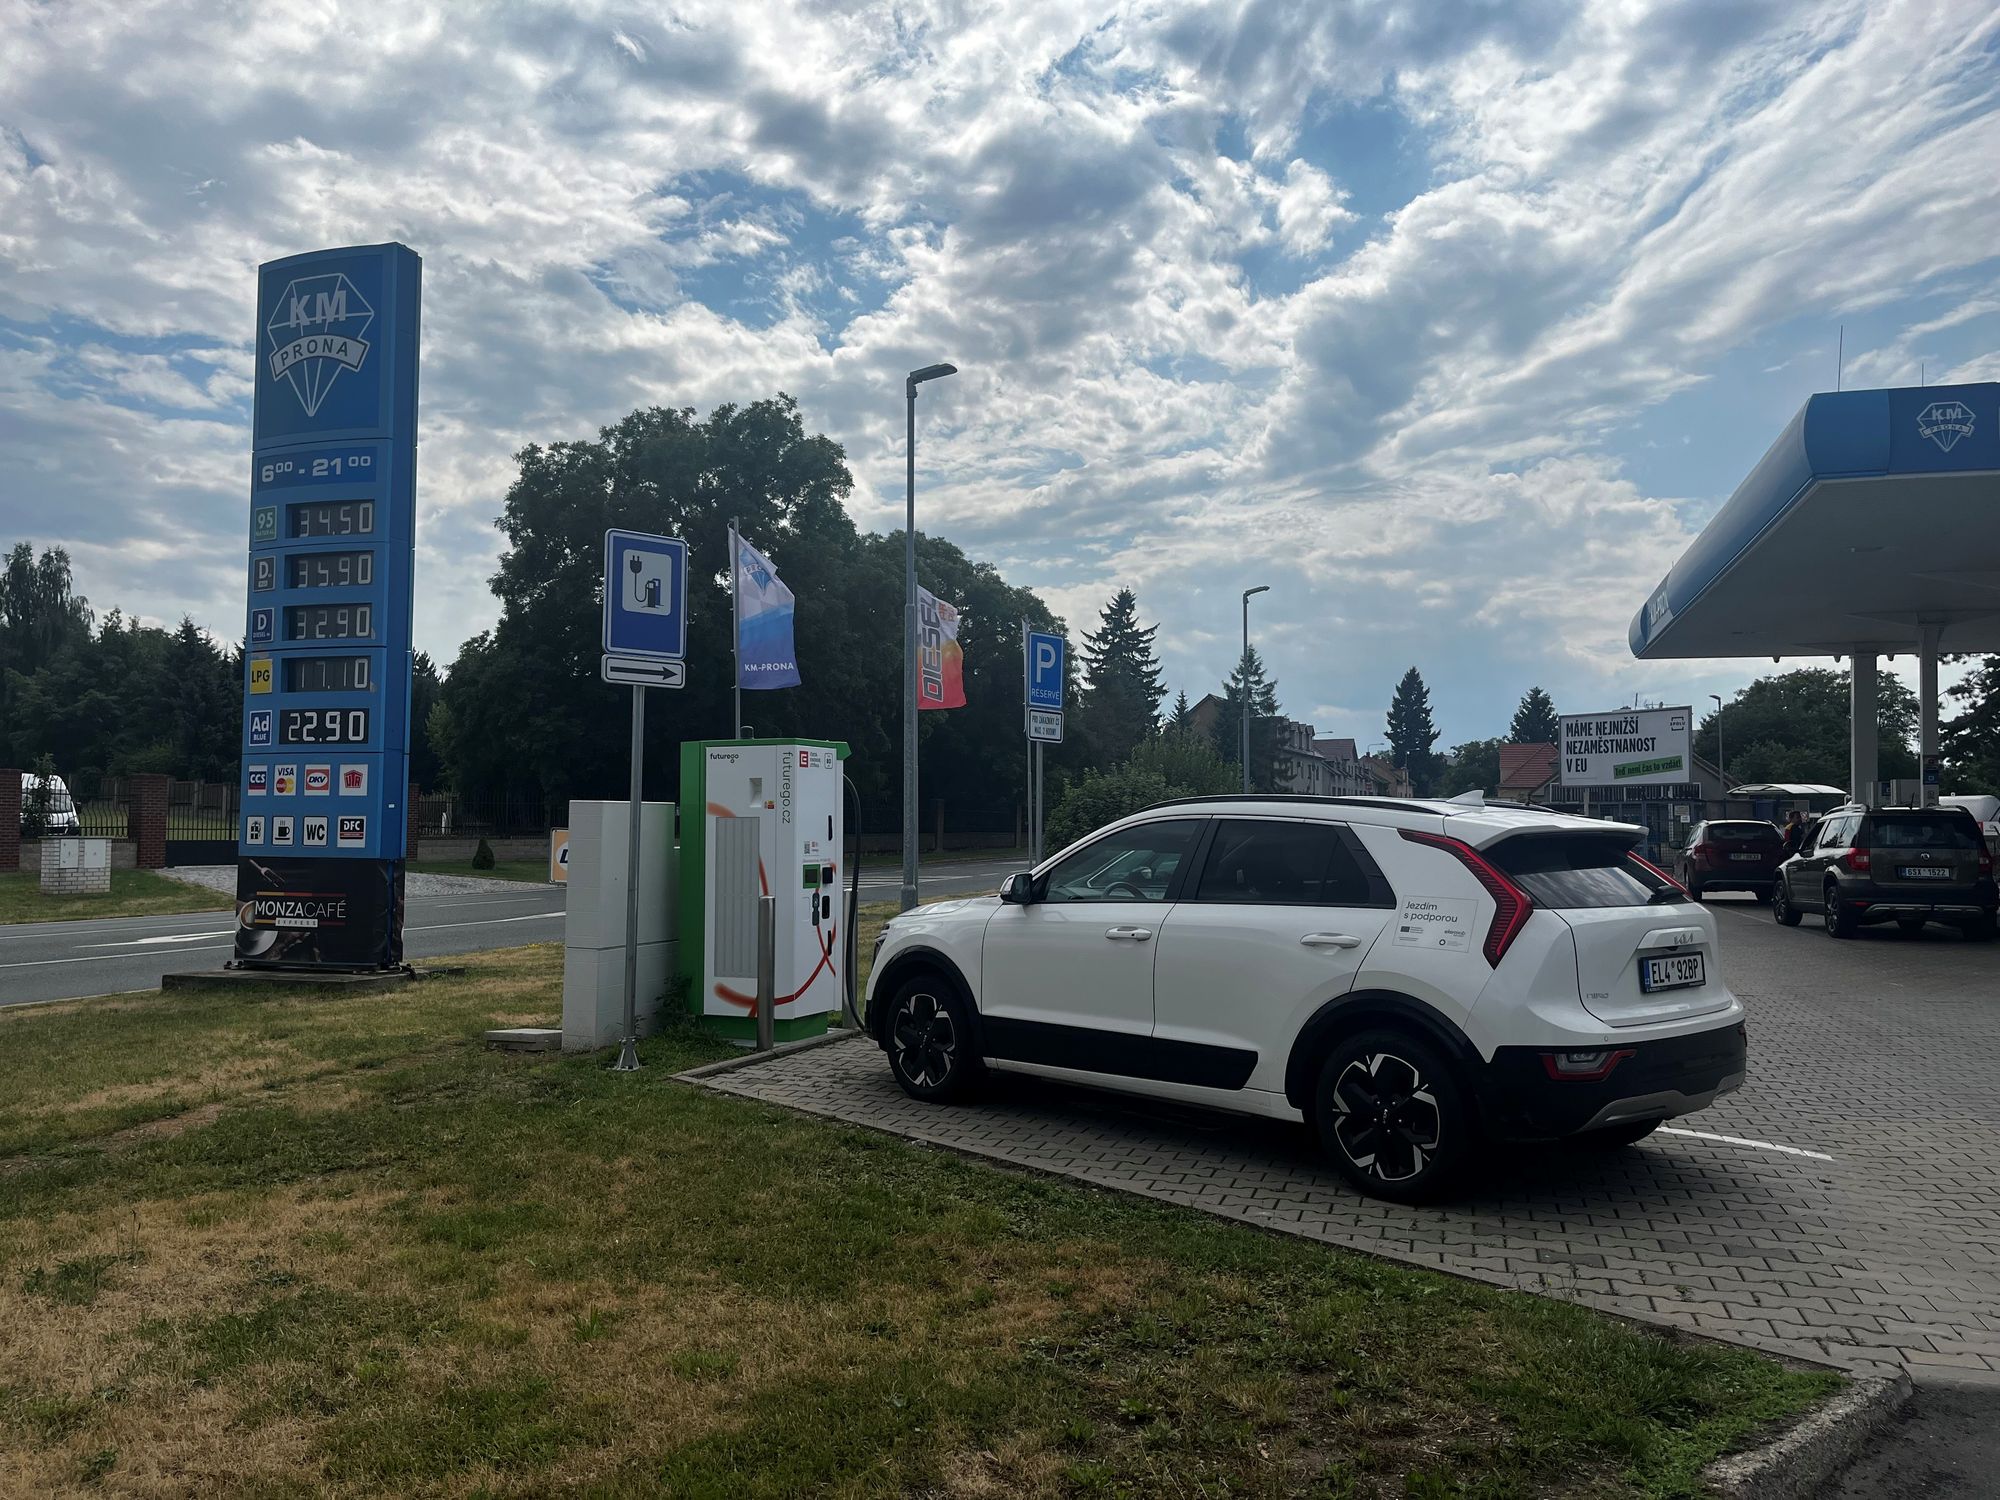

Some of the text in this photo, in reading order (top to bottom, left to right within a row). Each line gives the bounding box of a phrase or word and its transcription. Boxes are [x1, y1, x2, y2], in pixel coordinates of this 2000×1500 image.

[289, 289, 347, 329] KM
[279, 338, 350, 367] PRONA
[1931, 407, 1962, 421] KM
[257, 511, 274, 529] 95
[299, 502, 373, 538] 34.50
[298, 554, 372, 588] 35.90
[257, 614, 267, 631] D
[296, 606, 370, 640] 32.90
[920, 598, 944, 703] DIESEL
[744, 661, 795, 673] KM-PRONA
[1036, 642, 1056, 684] P
[251, 669, 270, 683] LPG
[301, 658, 369, 690] 17.10
[252, 715, 270, 732] Ad
[288, 711, 365, 742] 22.90
[1566, 716, 1640, 738] MÁME NEJNIŽŠÍ
[253, 733, 267, 741] BLUE
[1566, 736, 1657, 755] NEZAMĚSTNANOST
[277, 767, 295, 777] VISA
[1566, 758, 1588, 773] V EU
[249, 773, 266, 784] CCS
[307, 775, 327, 784] DKV
[779, 750, 794, 825] futurego.cz
[306, 823, 326, 841] WC
[343, 820, 361, 831] DFC
[1907, 868, 1946, 877] 6SX 1522
[254, 899, 347, 919] MONZACAFÉ
[1405, 900, 1438, 911] Jezdím
[276, 919, 318, 927] EXPRESS
[1409, 911, 1459, 924] podporou
[1650, 958, 1699, 984] EL4 92BP
